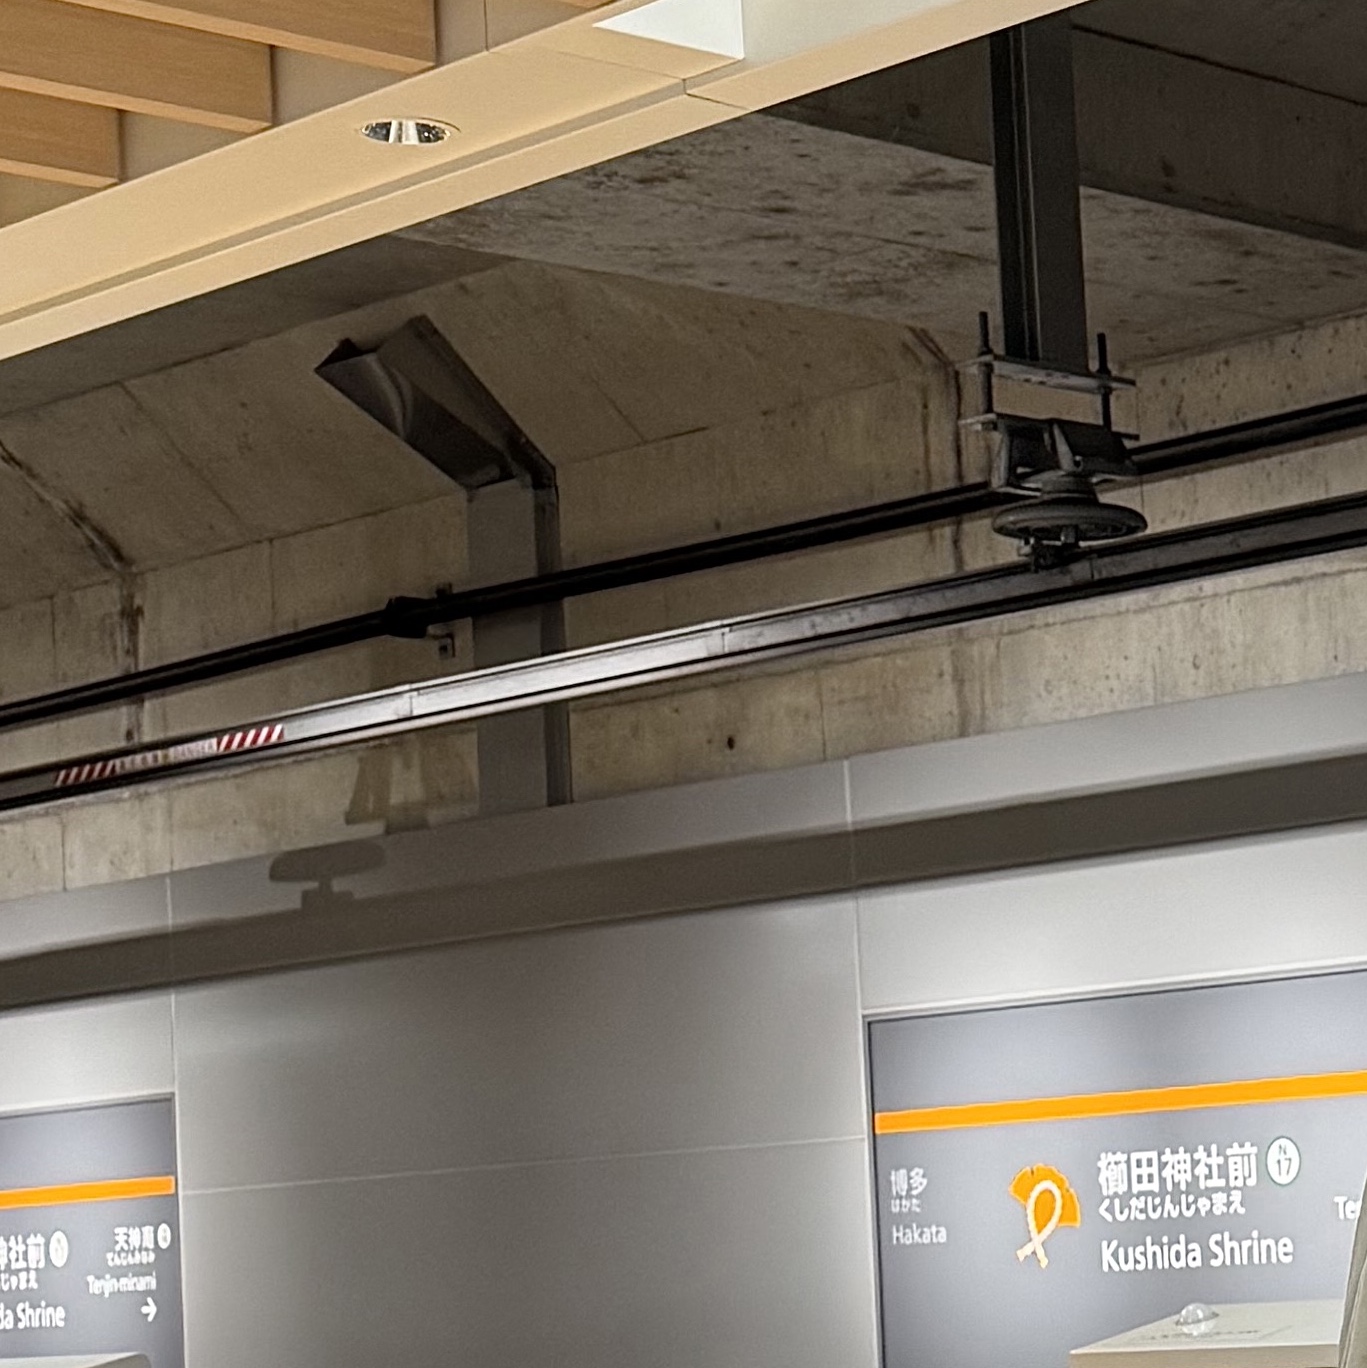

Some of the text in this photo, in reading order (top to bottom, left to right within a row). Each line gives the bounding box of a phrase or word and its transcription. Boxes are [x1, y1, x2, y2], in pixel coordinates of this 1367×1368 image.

[1098, 1141, 1258, 1195] 櫛田神社前
[1276, 1157, 1292, 1176] 17
[890, 1168, 928, 1197] 博多
[1099, 1190, 1246, 1222] くしだじんじゃまえ
[892, 1225, 947, 1245] Hakata
[1102, 1230, 1294, 1273] Kushida Shrine
[16, 1301, 65, 1329] Shrine
